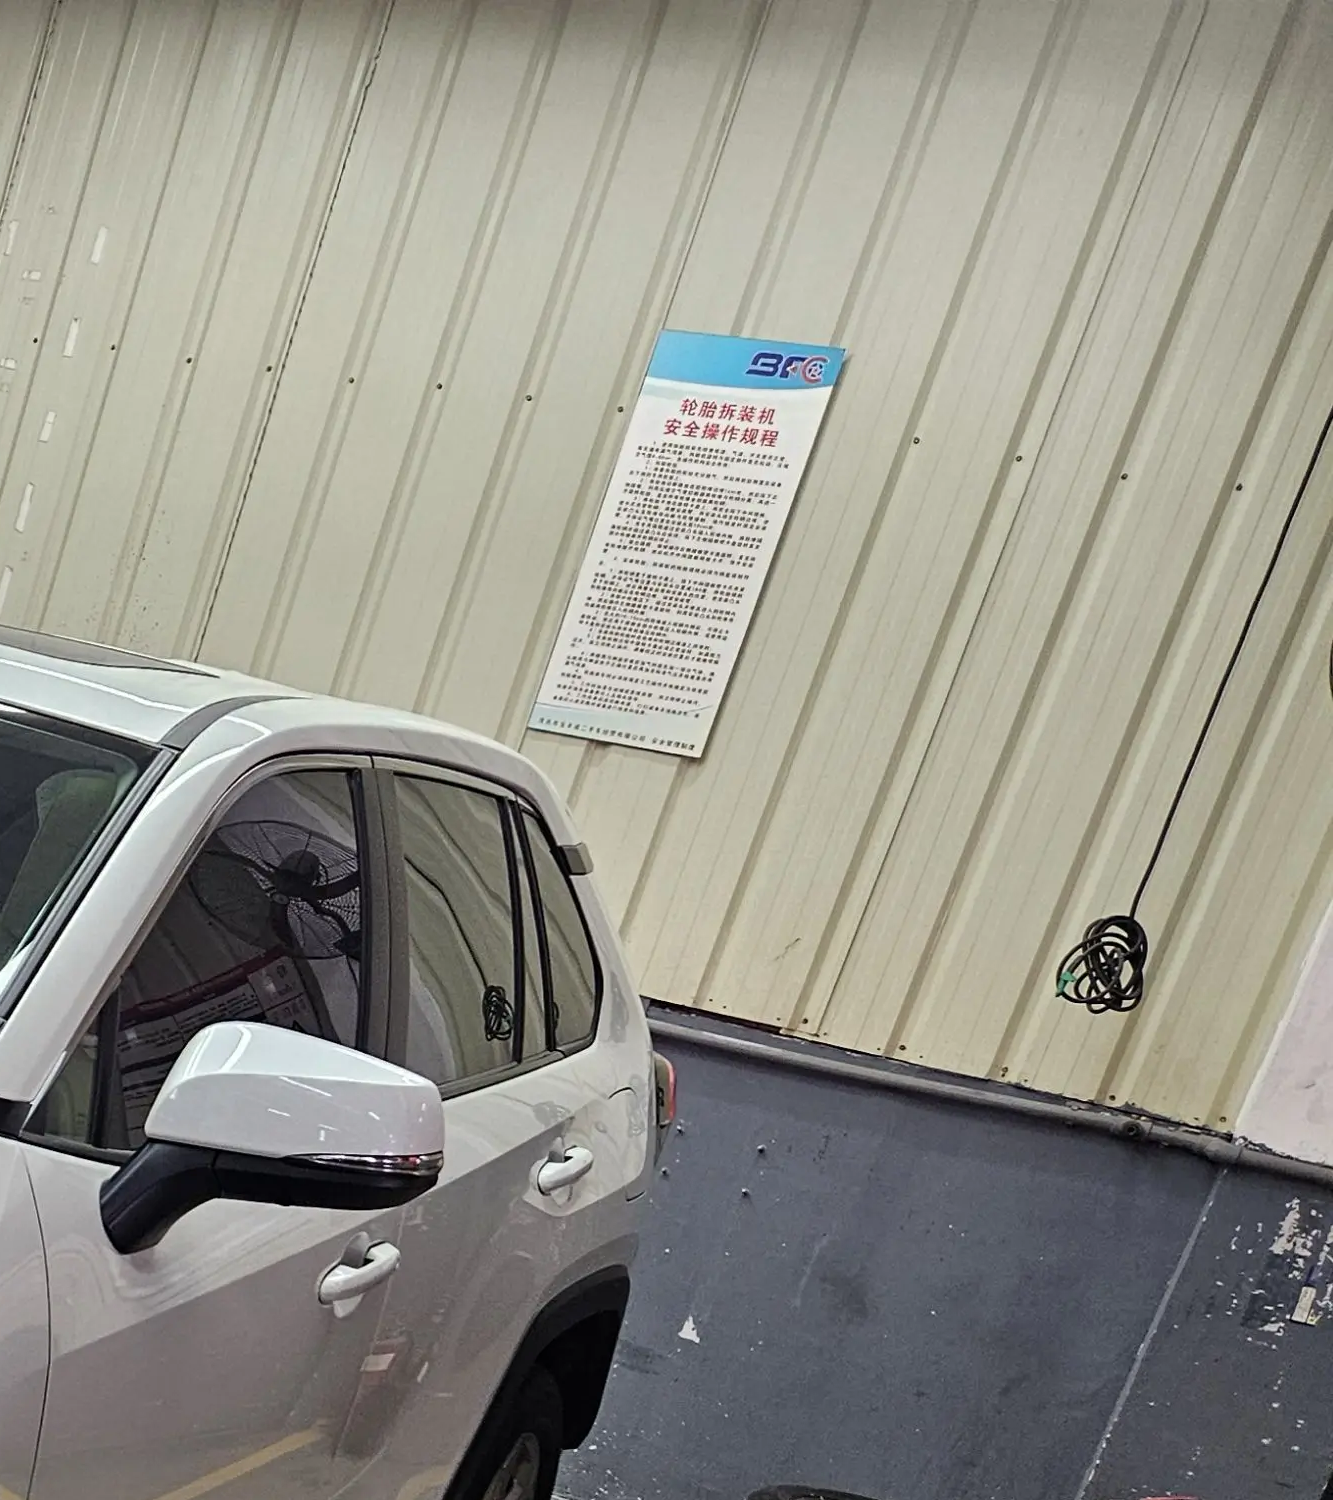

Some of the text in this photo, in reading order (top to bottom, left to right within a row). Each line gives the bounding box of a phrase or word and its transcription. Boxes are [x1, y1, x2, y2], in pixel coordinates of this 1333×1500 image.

[679, 397, 776, 426] 轮胎拆装机
[663, 418, 780, 448] 安全操作规程
